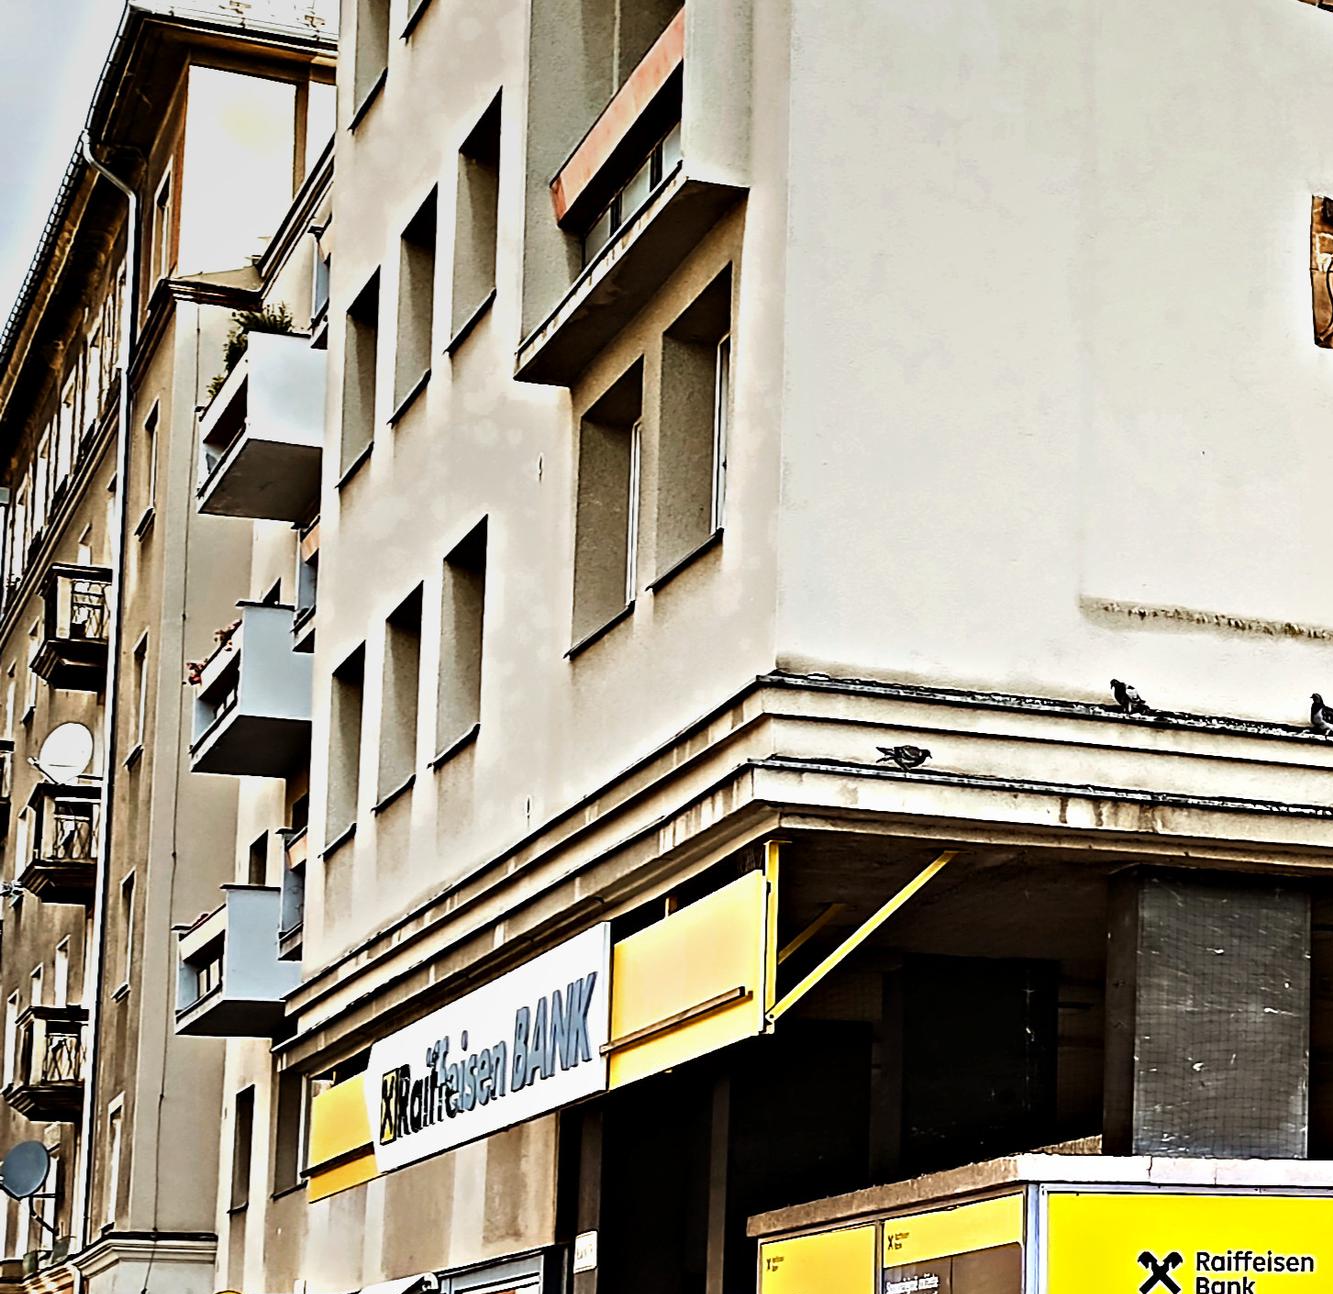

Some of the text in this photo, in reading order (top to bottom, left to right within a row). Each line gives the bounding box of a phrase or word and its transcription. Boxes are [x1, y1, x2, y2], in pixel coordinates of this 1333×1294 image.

[397, 971, 598, 1137] Raiffeisen BANK
[1195, 1250, 1315, 1273] Raiffeisen
